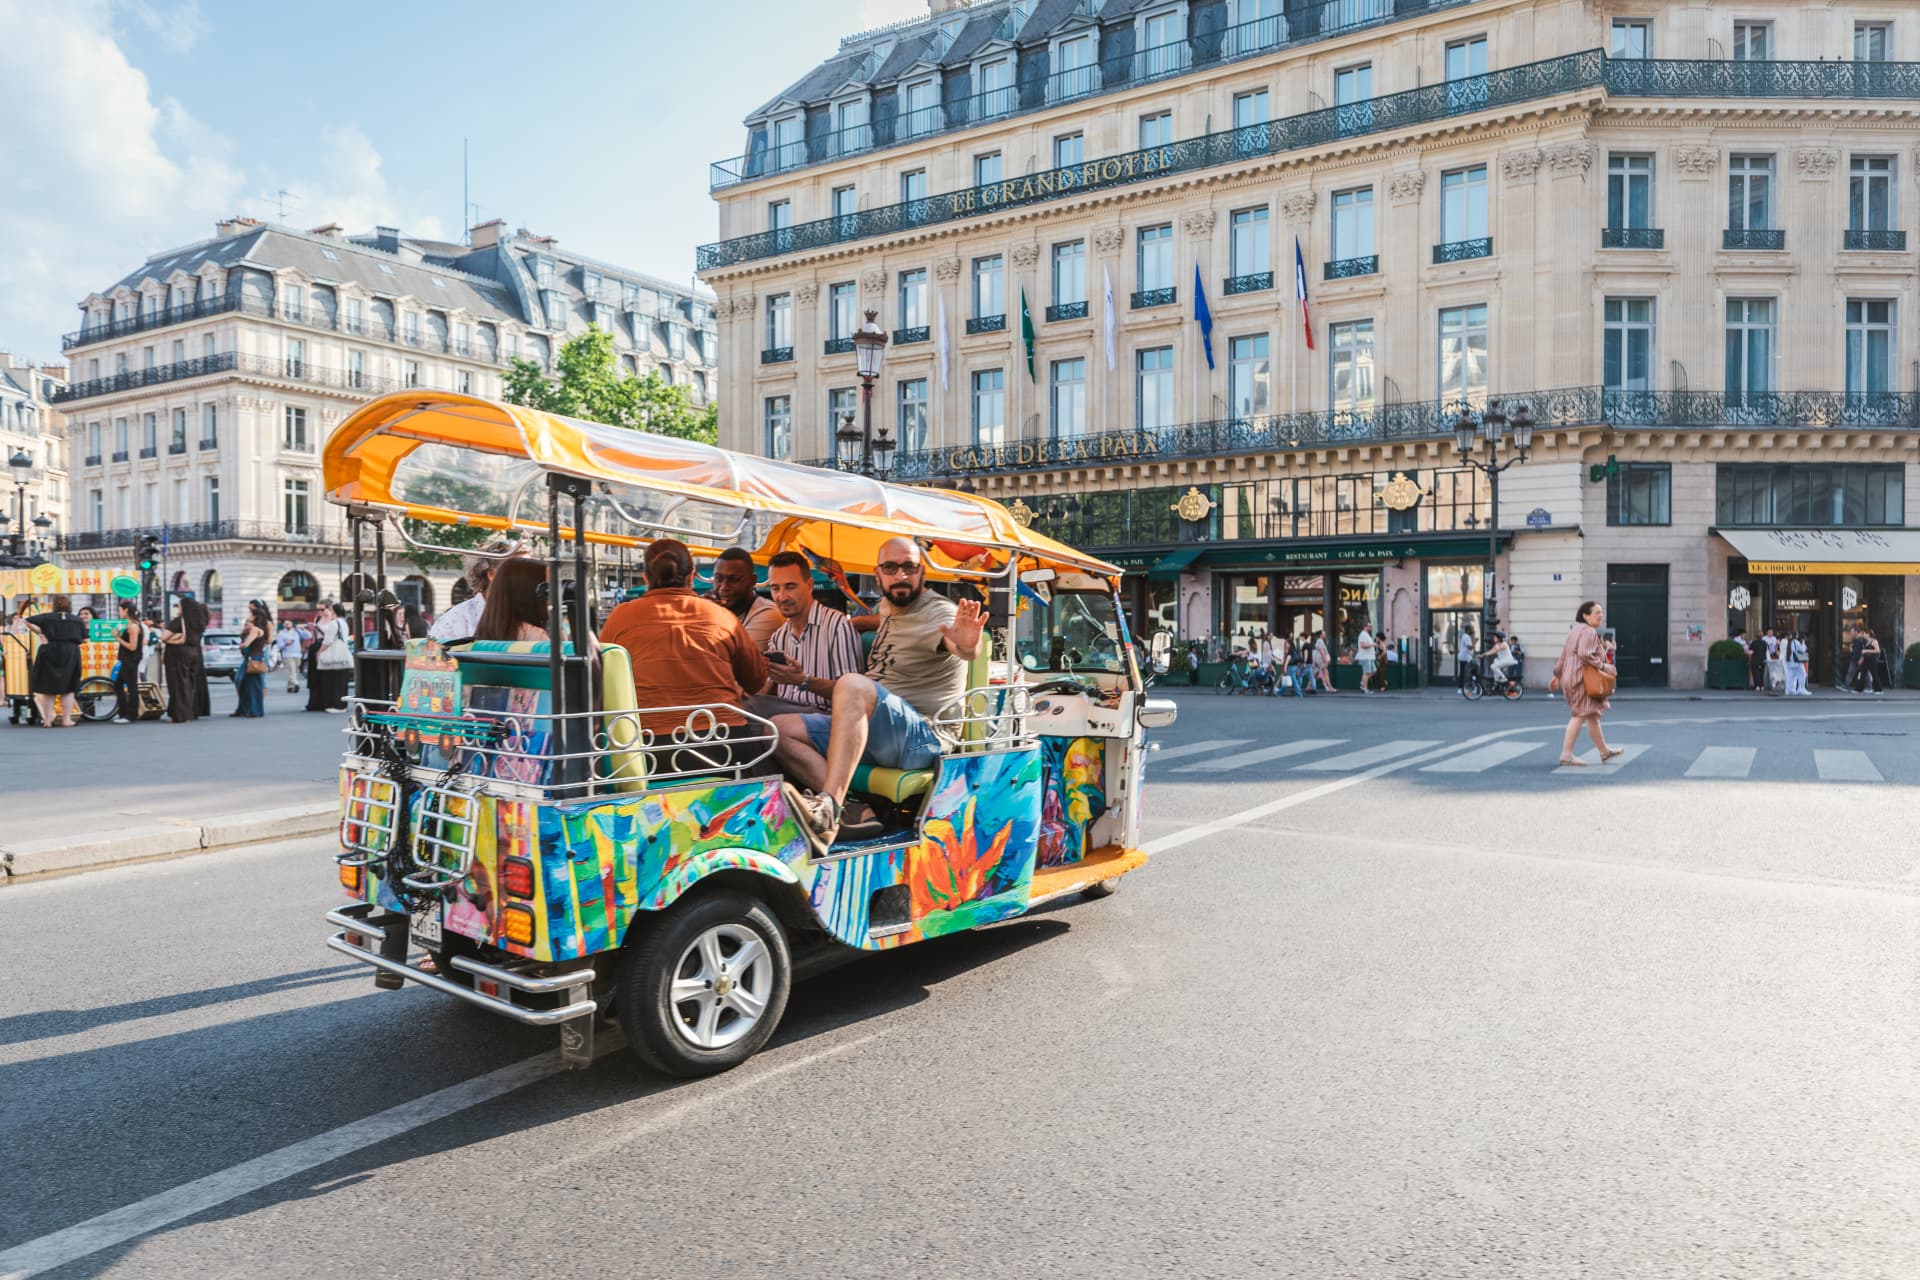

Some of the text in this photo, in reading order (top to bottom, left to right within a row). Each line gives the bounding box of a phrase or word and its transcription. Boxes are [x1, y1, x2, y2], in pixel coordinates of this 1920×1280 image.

[952, 149, 1172, 213] LE GRAND HOTEL
[1017, 441, 1049, 465] DE
[1058, 439, 1089, 461] LA
[1100, 432, 1160, 457] PAIX
[1377, 550, 1394, 558] PAIX
[68, 576, 101, 586] LUSH
